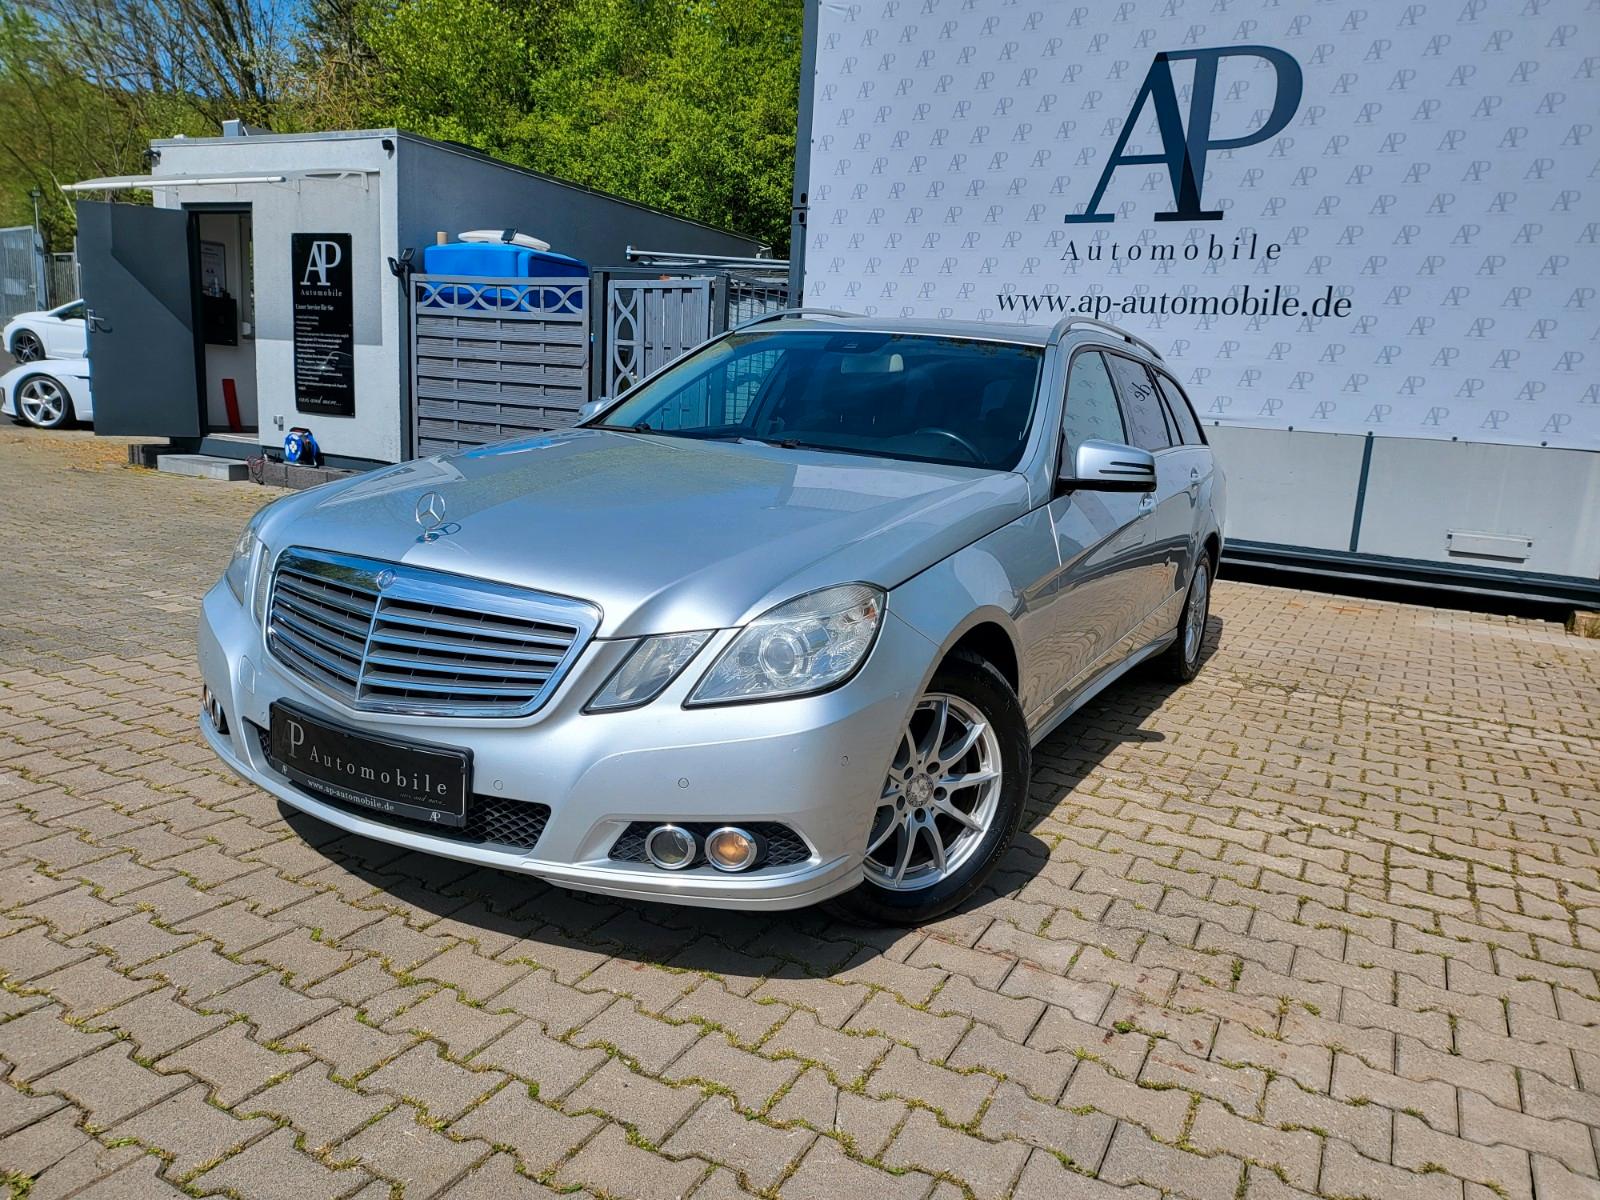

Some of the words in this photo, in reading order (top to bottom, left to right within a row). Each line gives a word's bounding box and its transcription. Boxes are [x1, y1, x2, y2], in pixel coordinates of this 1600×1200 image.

[1064, 45, 1303, 223] AP
[300, 241, 342, 286] AP
[1060, 233, 1283, 262] Automobile
[300, 288, 343, 297] Automobile
[996, 285, 1352, 319] www.ap-automobile.de
[309, 745, 448, 795] Automobile
[307, 778, 395, 812] www.ap-automobile.de
